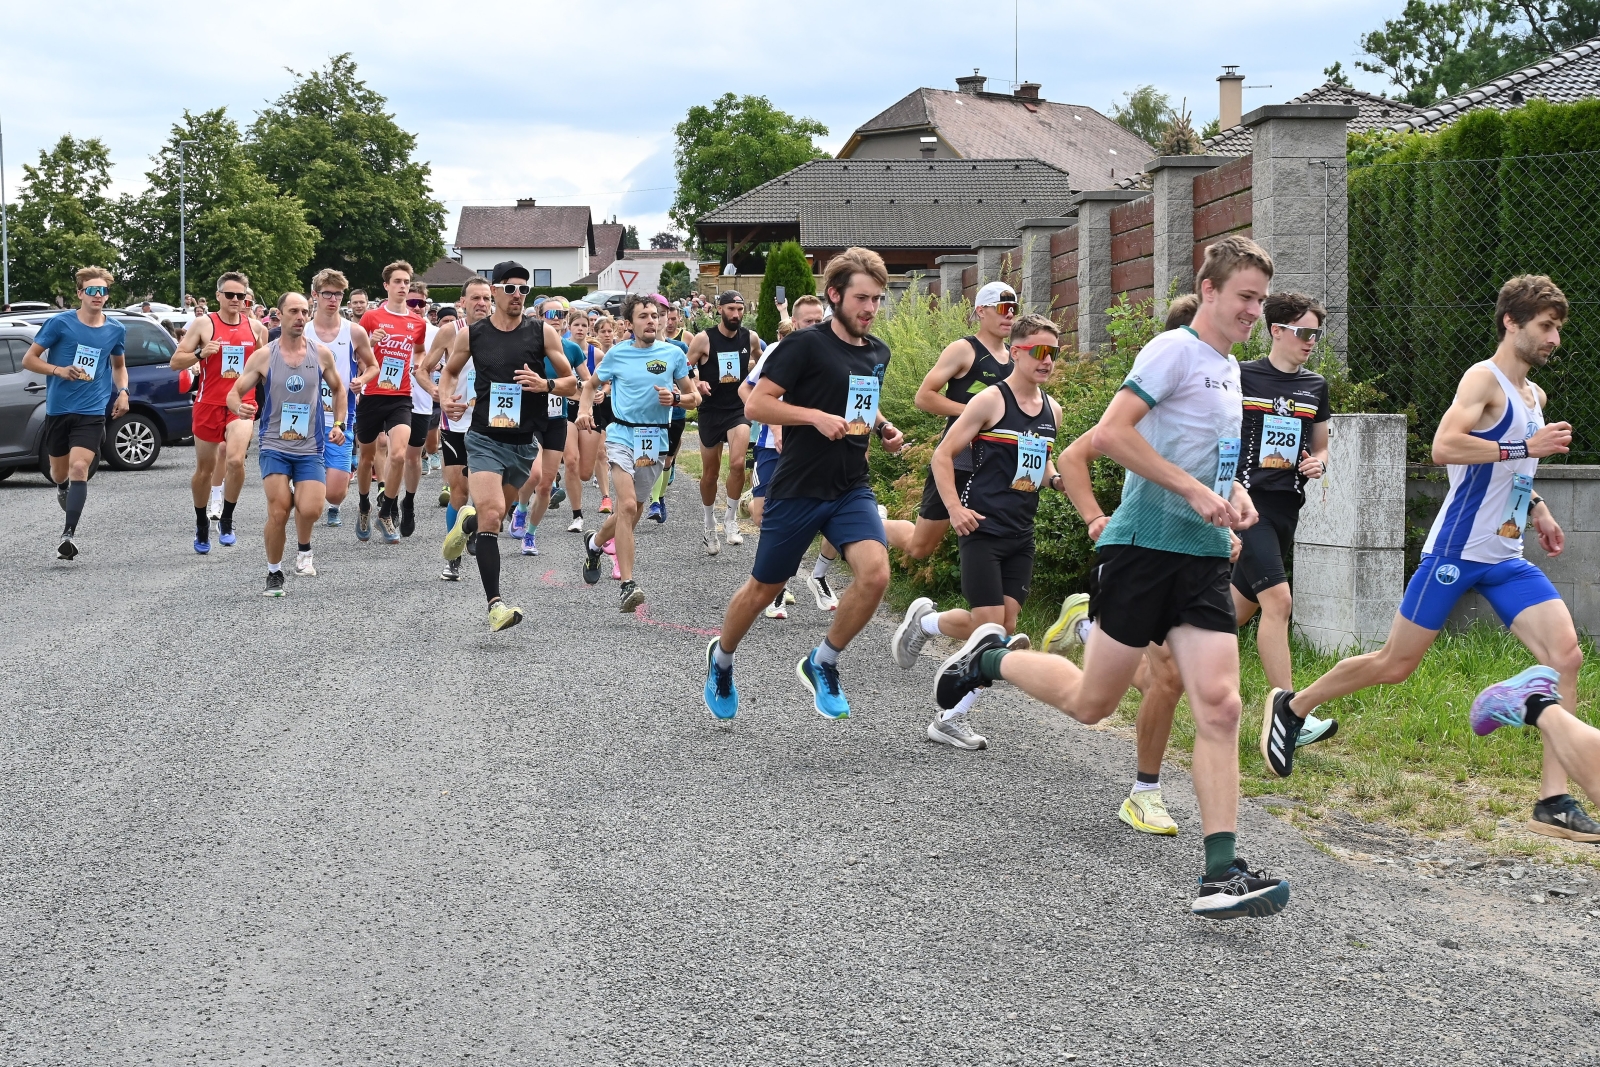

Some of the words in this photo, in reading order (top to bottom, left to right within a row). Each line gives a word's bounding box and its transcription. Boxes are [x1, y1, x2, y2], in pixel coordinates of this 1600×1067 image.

[378, 333, 412, 351] Carla
[78, 355, 95, 367] 102
[227, 355, 239, 365] 72
[726, 361, 733, 370] 8
[385, 366, 399, 377] 117
[497, 396, 514, 408] 25
[854, 393, 872, 410] 24
[291, 414, 299, 425] 7
[641, 439, 653, 450] 12
[1265, 430, 1296, 447] 228
[1022, 452, 1042, 470] 210
[1218, 461, 1236, 482] 223
[1514, 494, 1523, 511] 1
